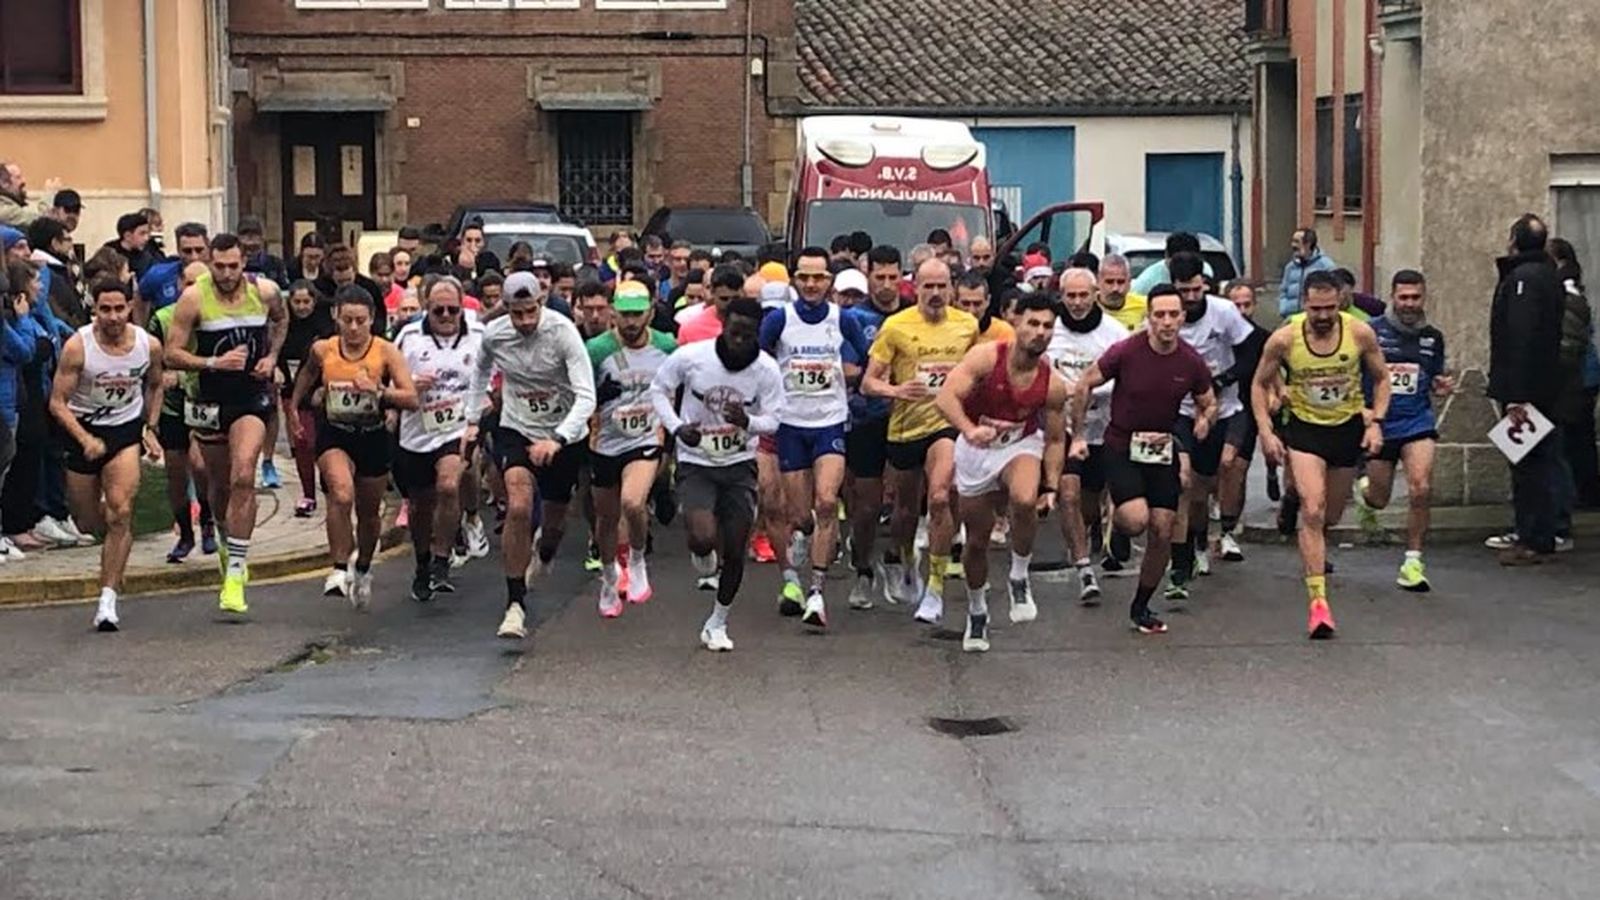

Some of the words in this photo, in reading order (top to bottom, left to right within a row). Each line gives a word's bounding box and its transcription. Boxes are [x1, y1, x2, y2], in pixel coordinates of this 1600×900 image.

[798, 371, 827, 385] 136
[1392, 373, 1411, 387] 20
[105, 388, 127, 401] 79
[342, 393, 361, 407] 67
[1320, 387, 1340, 401] 21
[529, 399, 549, 413] 55
[434, 408, 454, 424] 82
[712, 434, 741, 451] 104
